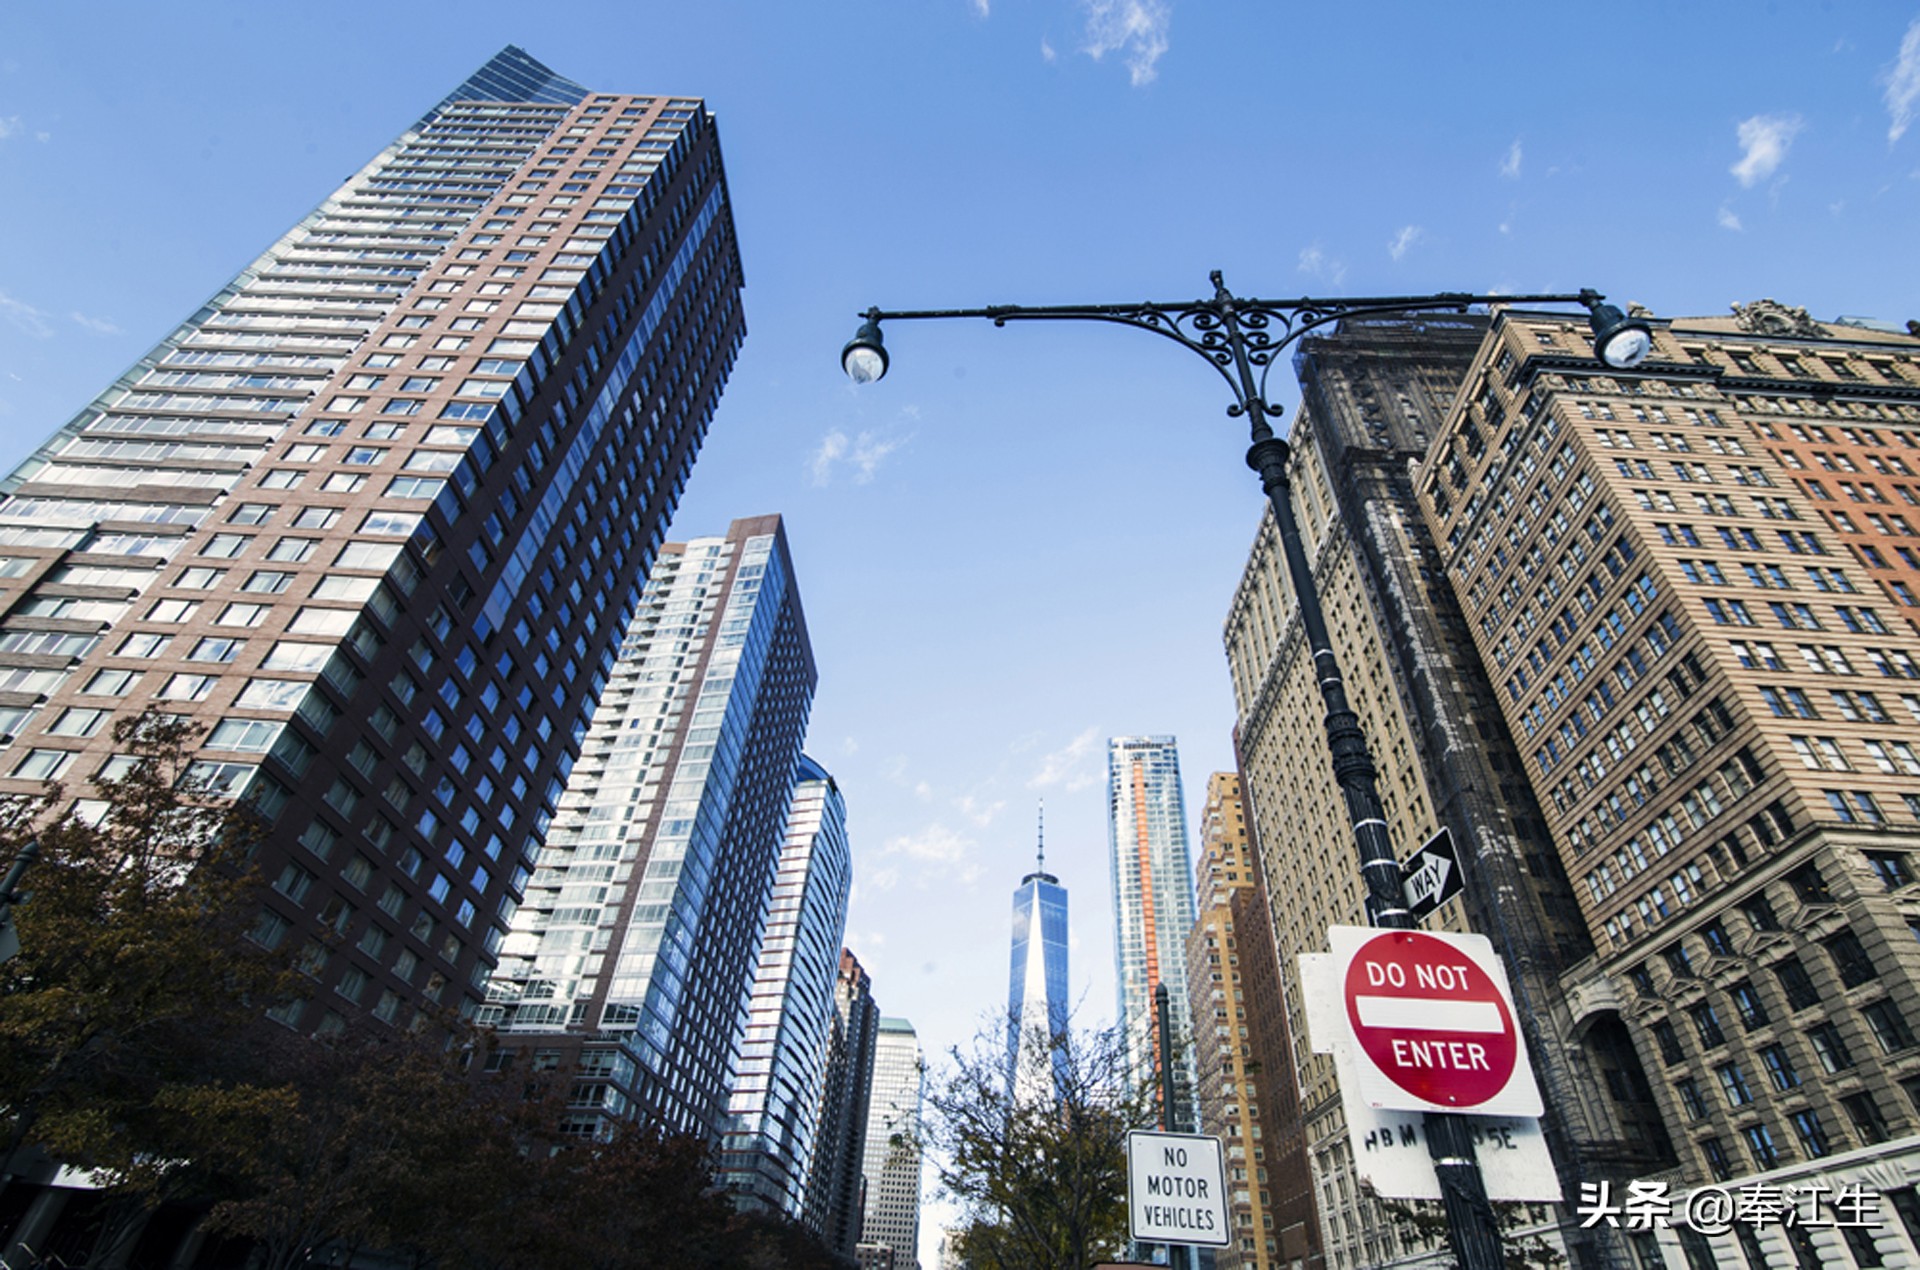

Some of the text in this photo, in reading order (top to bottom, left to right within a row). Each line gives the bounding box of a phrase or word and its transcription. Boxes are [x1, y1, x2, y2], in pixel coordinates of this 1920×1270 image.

[1411, 859, 1441, 900] WAY
[1366, 961, 1469, 991] DO NOT
[1392, 1039, 1491, 1071] ENTER
[1164, 1147, 1187, 1167] NO
[1148, 1175, 1208, 1199] MOTOR
[1144, 1205, 1214, 1231] VEHICLES
